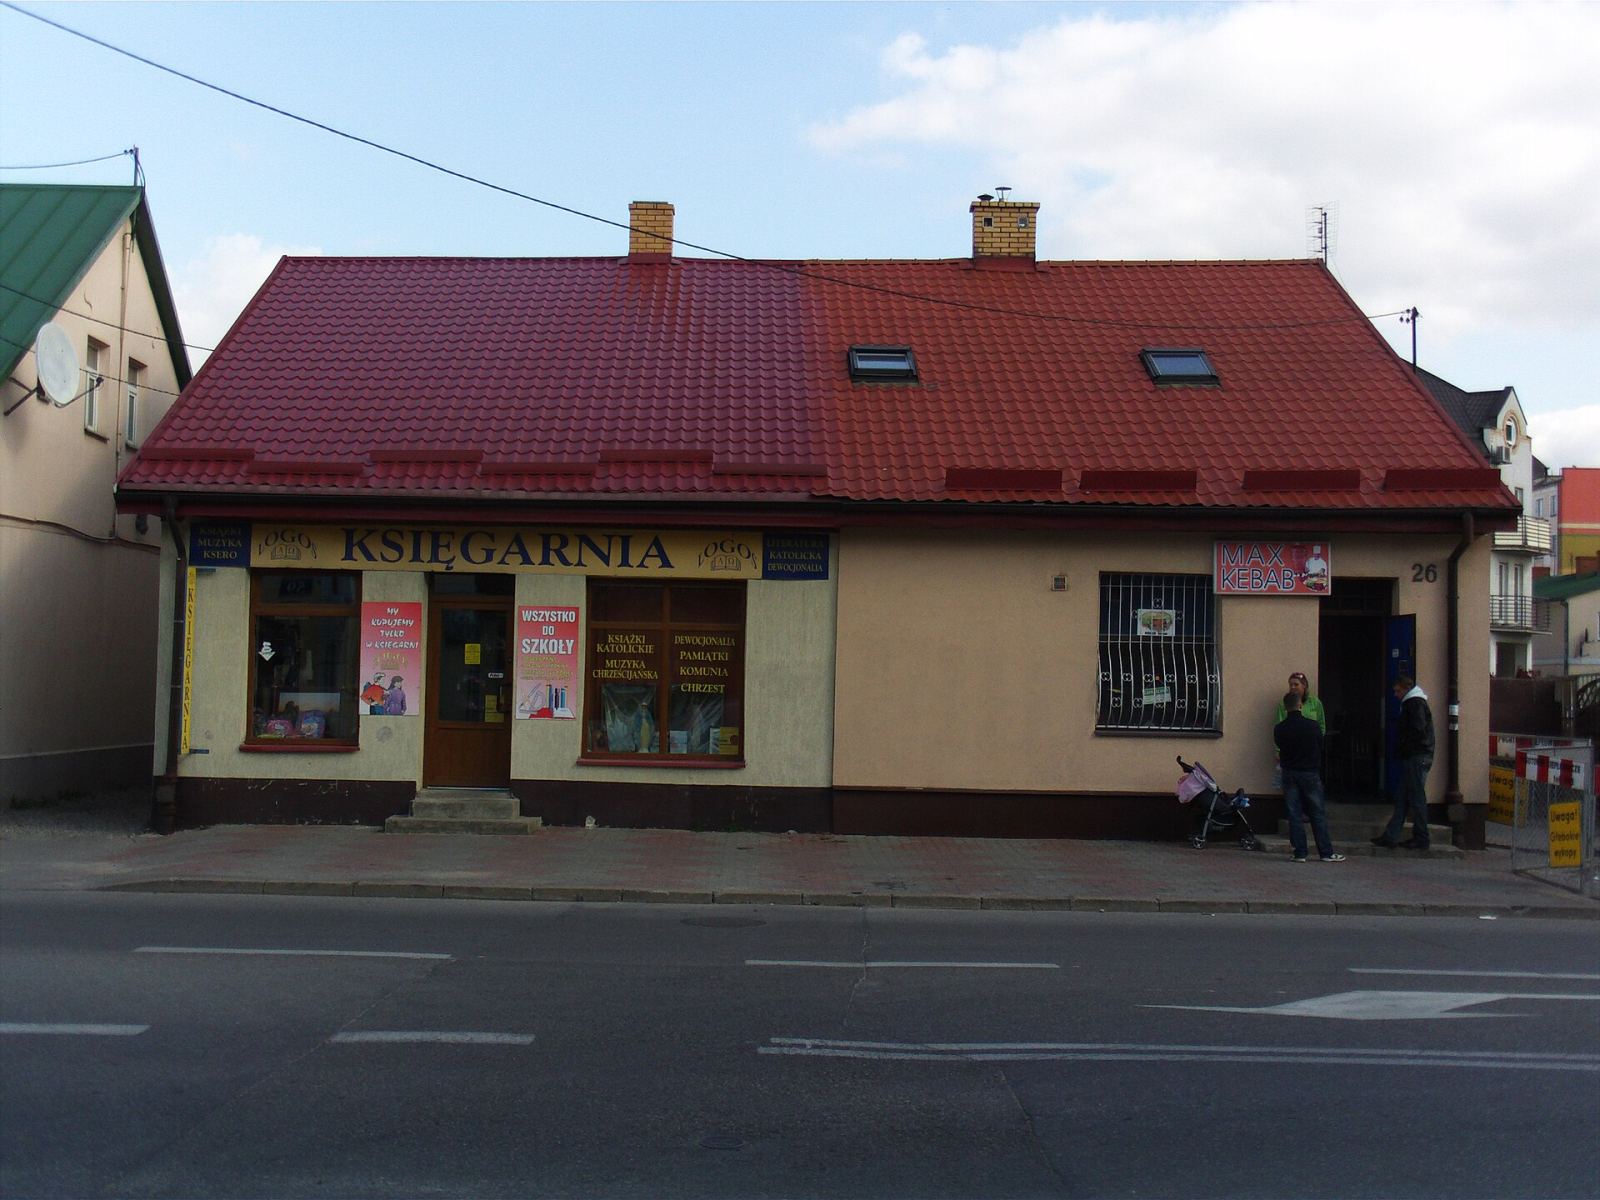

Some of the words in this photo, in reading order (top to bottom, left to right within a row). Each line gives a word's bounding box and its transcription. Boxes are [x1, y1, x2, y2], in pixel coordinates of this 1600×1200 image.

[198, 538, 243, 548] MUZYKA
[341, 527, 675, 570] KSIĘGARNIA
[203, 549, 238, 560] KSERO
[769, 550, 823, 560] KATOLICKA
[1220, 543, 1285, 567] MAX
[767, 562, 823, 573] DEWOCJONALIA
[1220, 567, 1296, 591] KEBAB
[1411, 563, 1438, 584] 26
[386, 607, 399, 616] MY
[521, 609, 576, 623] WSZYSTKO
[371, 618, 414, 629] KUPUJEMY
[380, 629, 405, 638] TYLKO
[542, 625, 555, 636] DO
[607, 632, 646, 645] KSIĄŻKI
[674, 634, 736, 647] DEWOCJONALIA
[365, 641, 373, 649] W
[521, 638, 575, 655] SZKOŁY
[597, 643, 655, 654] KATOLICKIE
[679, 650, 729, 662] PAMIĄTKI
[605, 659, 646, 669] MUZYKA
[592, 669, 659, 681] CHRZEŚCIJAŃSKA
[679, 666, 729, 677] KOMUNIA
[680, 682, 726, 694] CHRZEST
